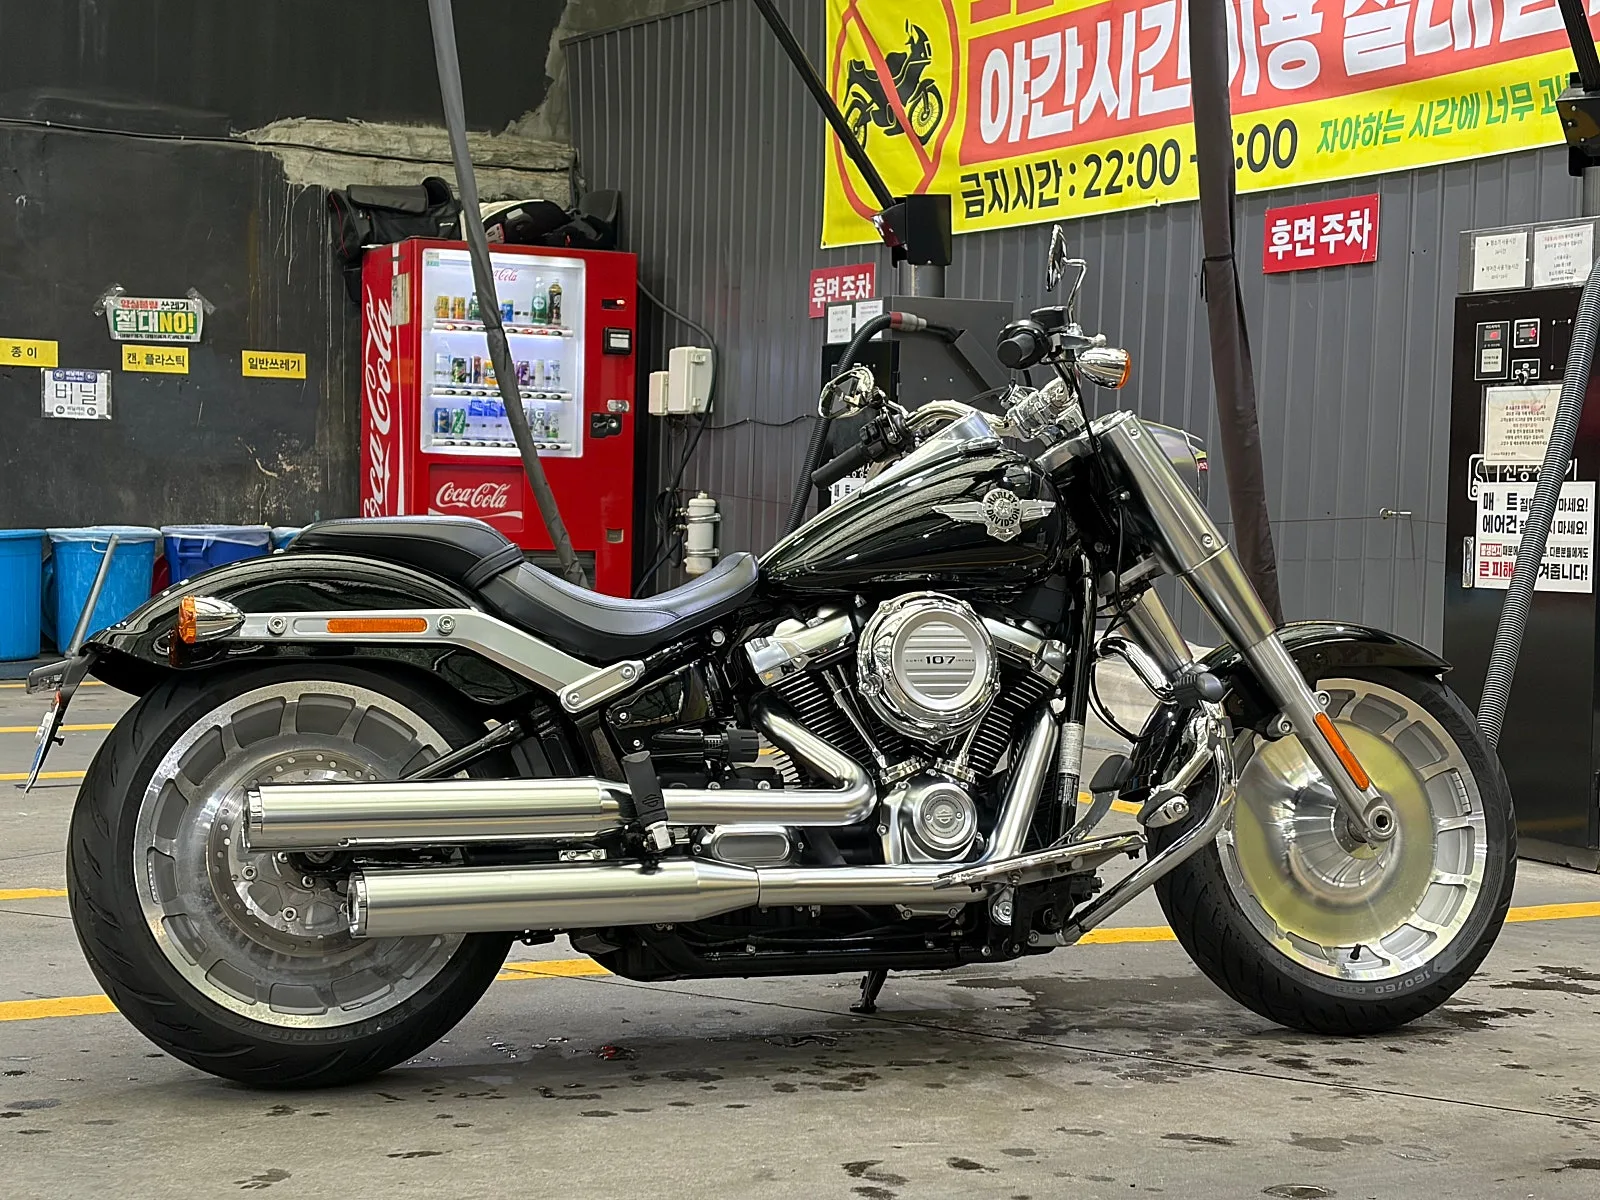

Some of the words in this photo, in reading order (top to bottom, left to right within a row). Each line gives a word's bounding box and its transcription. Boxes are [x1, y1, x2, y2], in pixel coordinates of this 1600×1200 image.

[980, 0, 1191, 144] 야간시간
[1316, 108, 1405, 154] 자야하는
[1408, 92, 1480, 139] 시간에
[1485, 81, 1534, 126] 너무
[1539, 73, 1570, 115] 괴
[960, 158, 1063, 218] 금지시간
[1083, 138, 1181, 199] 22:00
[1235, 119, 1298, 172] :00
[161, 301, 189, 310] 쓰레기
[144, 353, 185, 368] 플라스틱
[435, 481, 511, 508] Coca-Cola
[987, 491, 1018, 504] HARLEY
[1558, 498, 1588, 513] 마세요!
[986, 508, 1020, 527] DAVIDSON
[1482, 514, 1517, 534] 에어건
[1557, 520, 1588, 535] 마세요!
[1480, 561, 1489, 577] 큰
[1492, 561, 1514, 578] 피해
[1539, 563, 1588, 580] 겨줍니다!
[926, 655, 956, 665] 107
